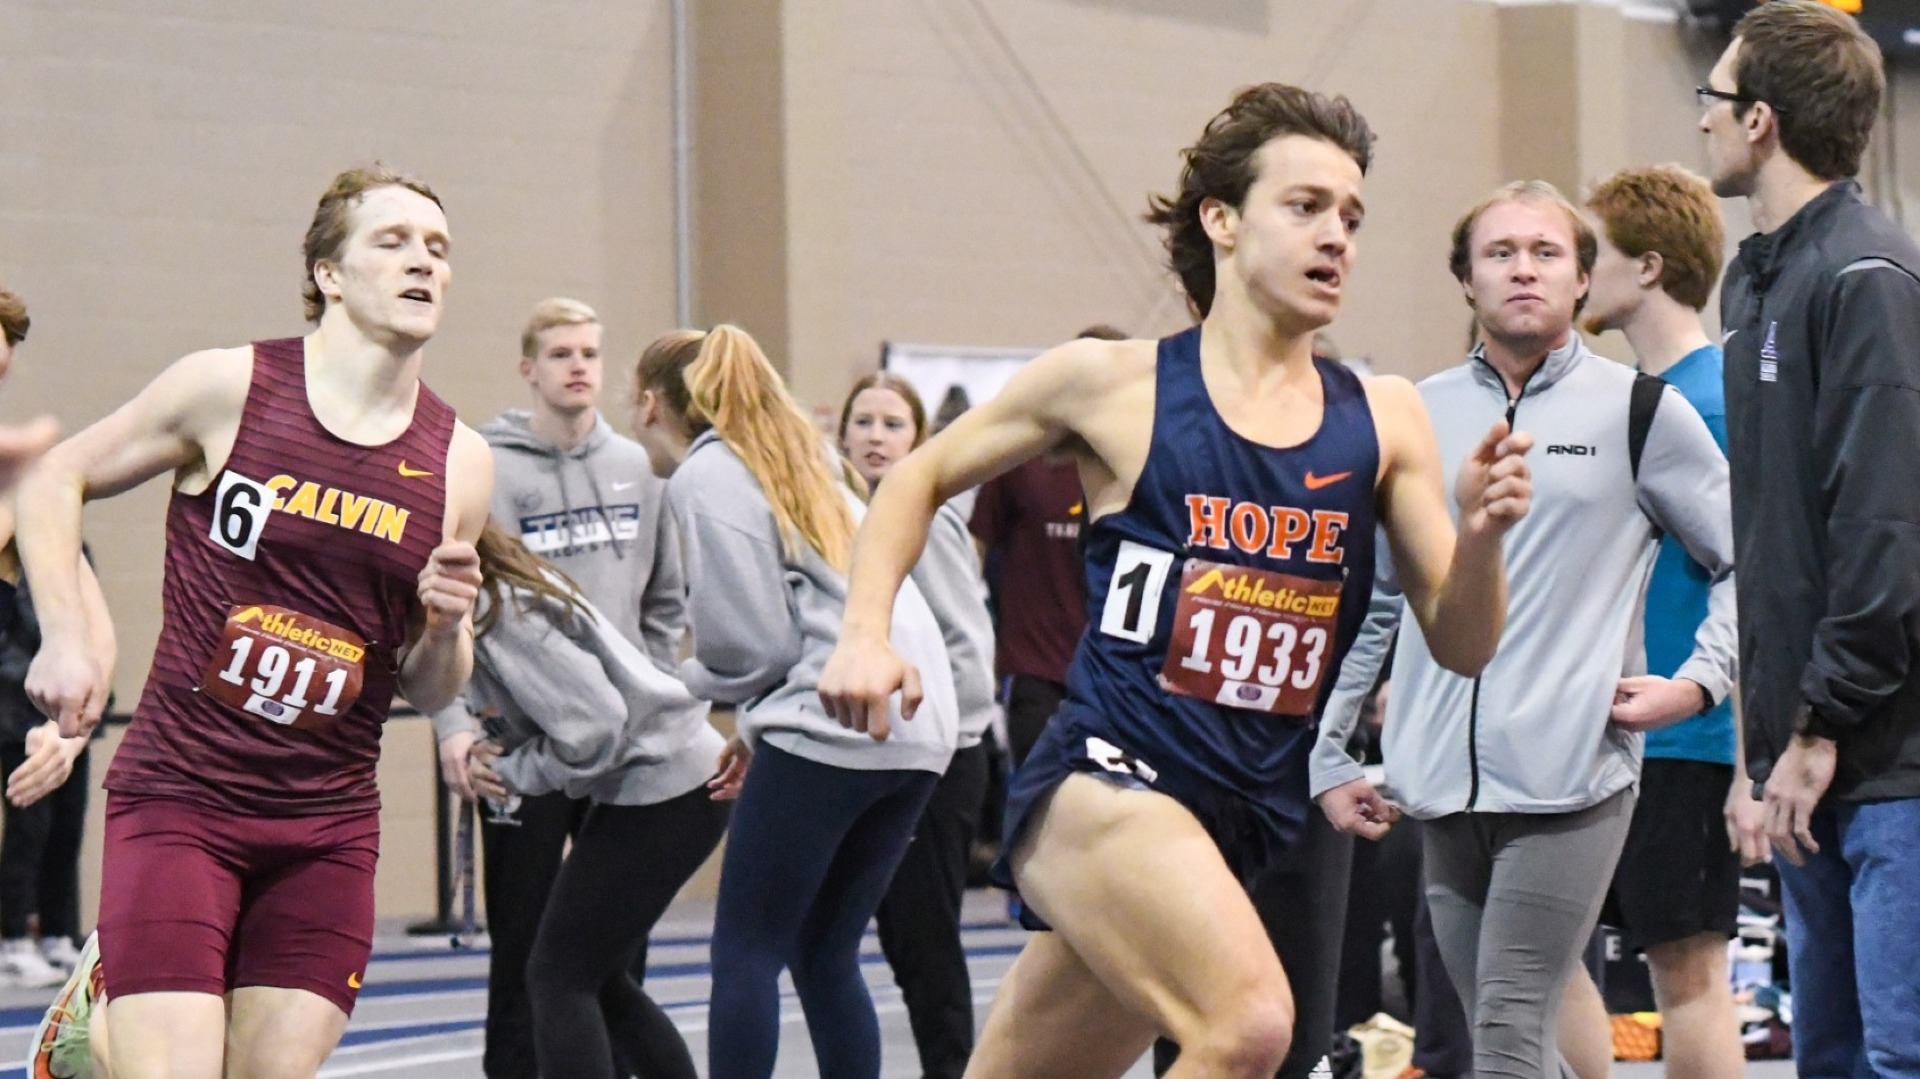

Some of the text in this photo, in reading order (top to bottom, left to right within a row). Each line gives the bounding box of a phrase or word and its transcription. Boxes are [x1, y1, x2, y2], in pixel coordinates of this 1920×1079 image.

[219, 482, 260, 548] 6
[264, 474, 411, 544] CALVIN
[1185, 494, 1349, 563] HOPE
[1117, 562, 1152, 632] 1
[1186, 569, 1308, 614] Athletic
[231, 607, 331, 650] Athletic
[1181, 608, 1327, 689] 1933
[219, 636, 347, 715] 1911
